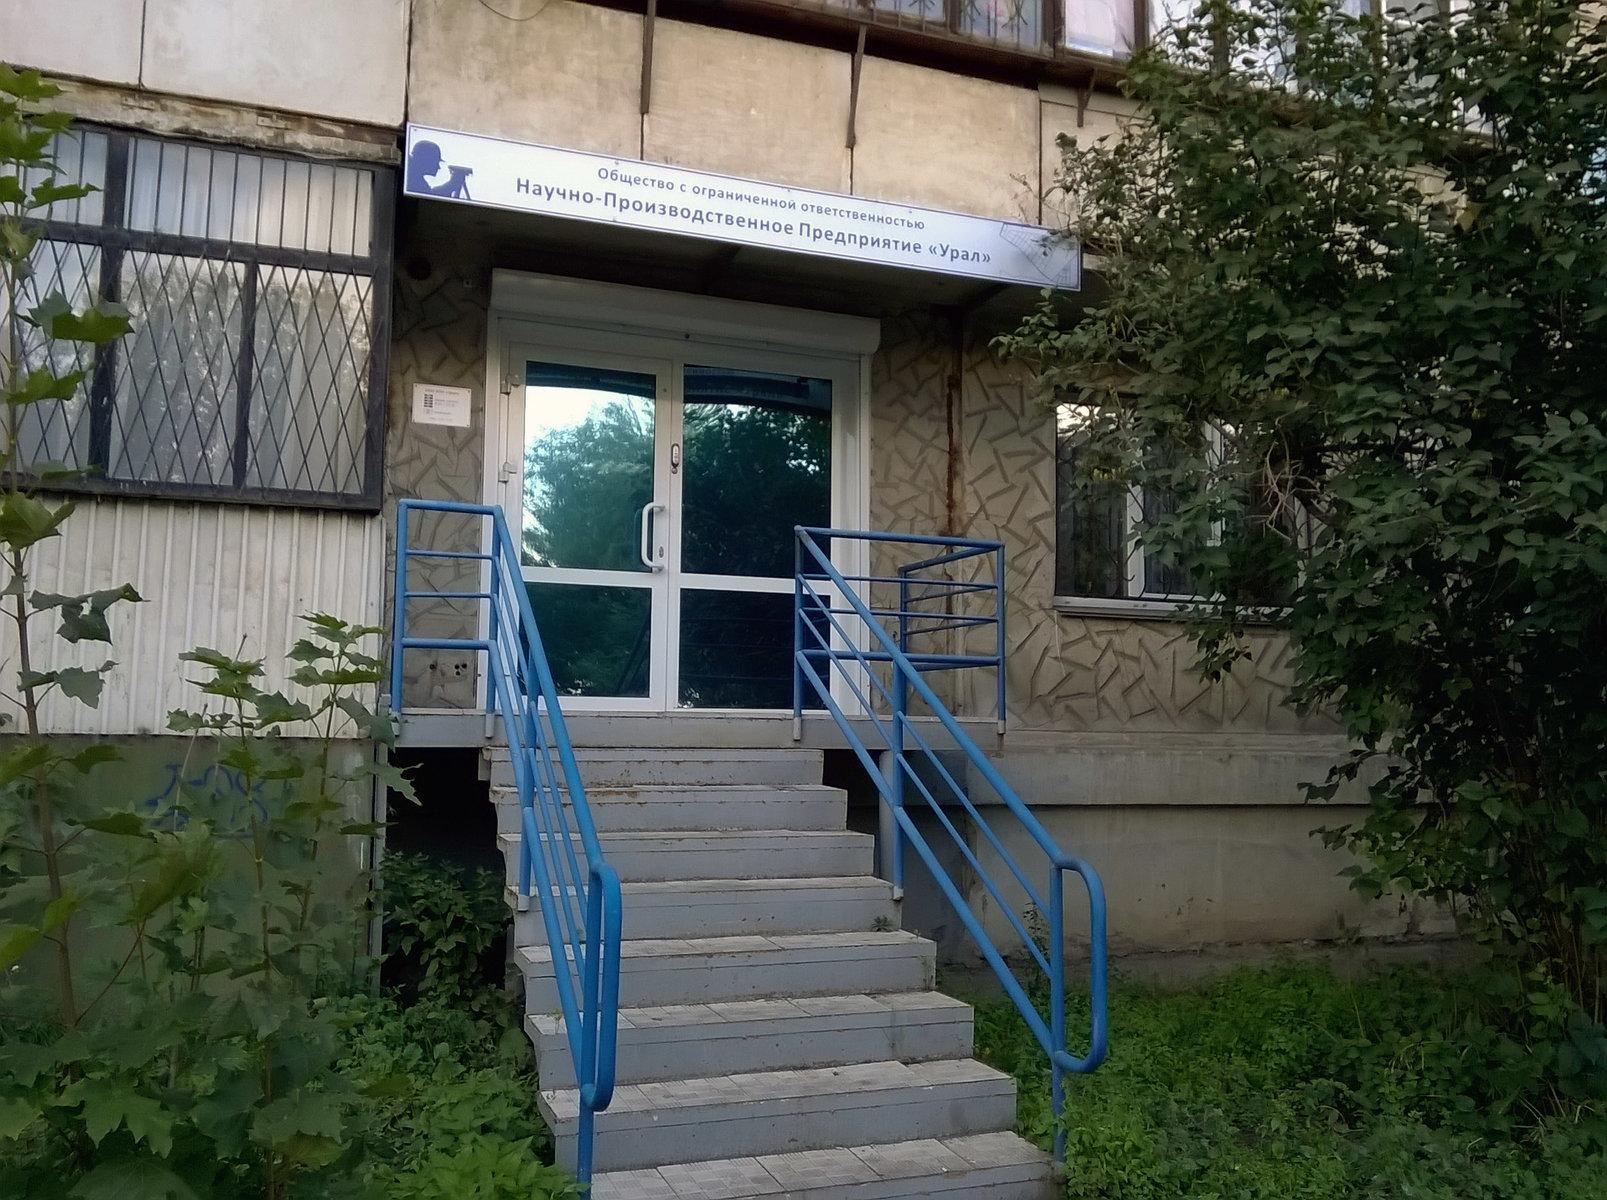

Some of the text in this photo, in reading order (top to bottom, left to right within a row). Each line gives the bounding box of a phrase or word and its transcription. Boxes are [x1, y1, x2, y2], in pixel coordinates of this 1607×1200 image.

[516, 177, 991, 264] Научно-Производственное Предприятие «Урал»
[598, 167, 925, 230] Общество с ограниченной ответственностью
